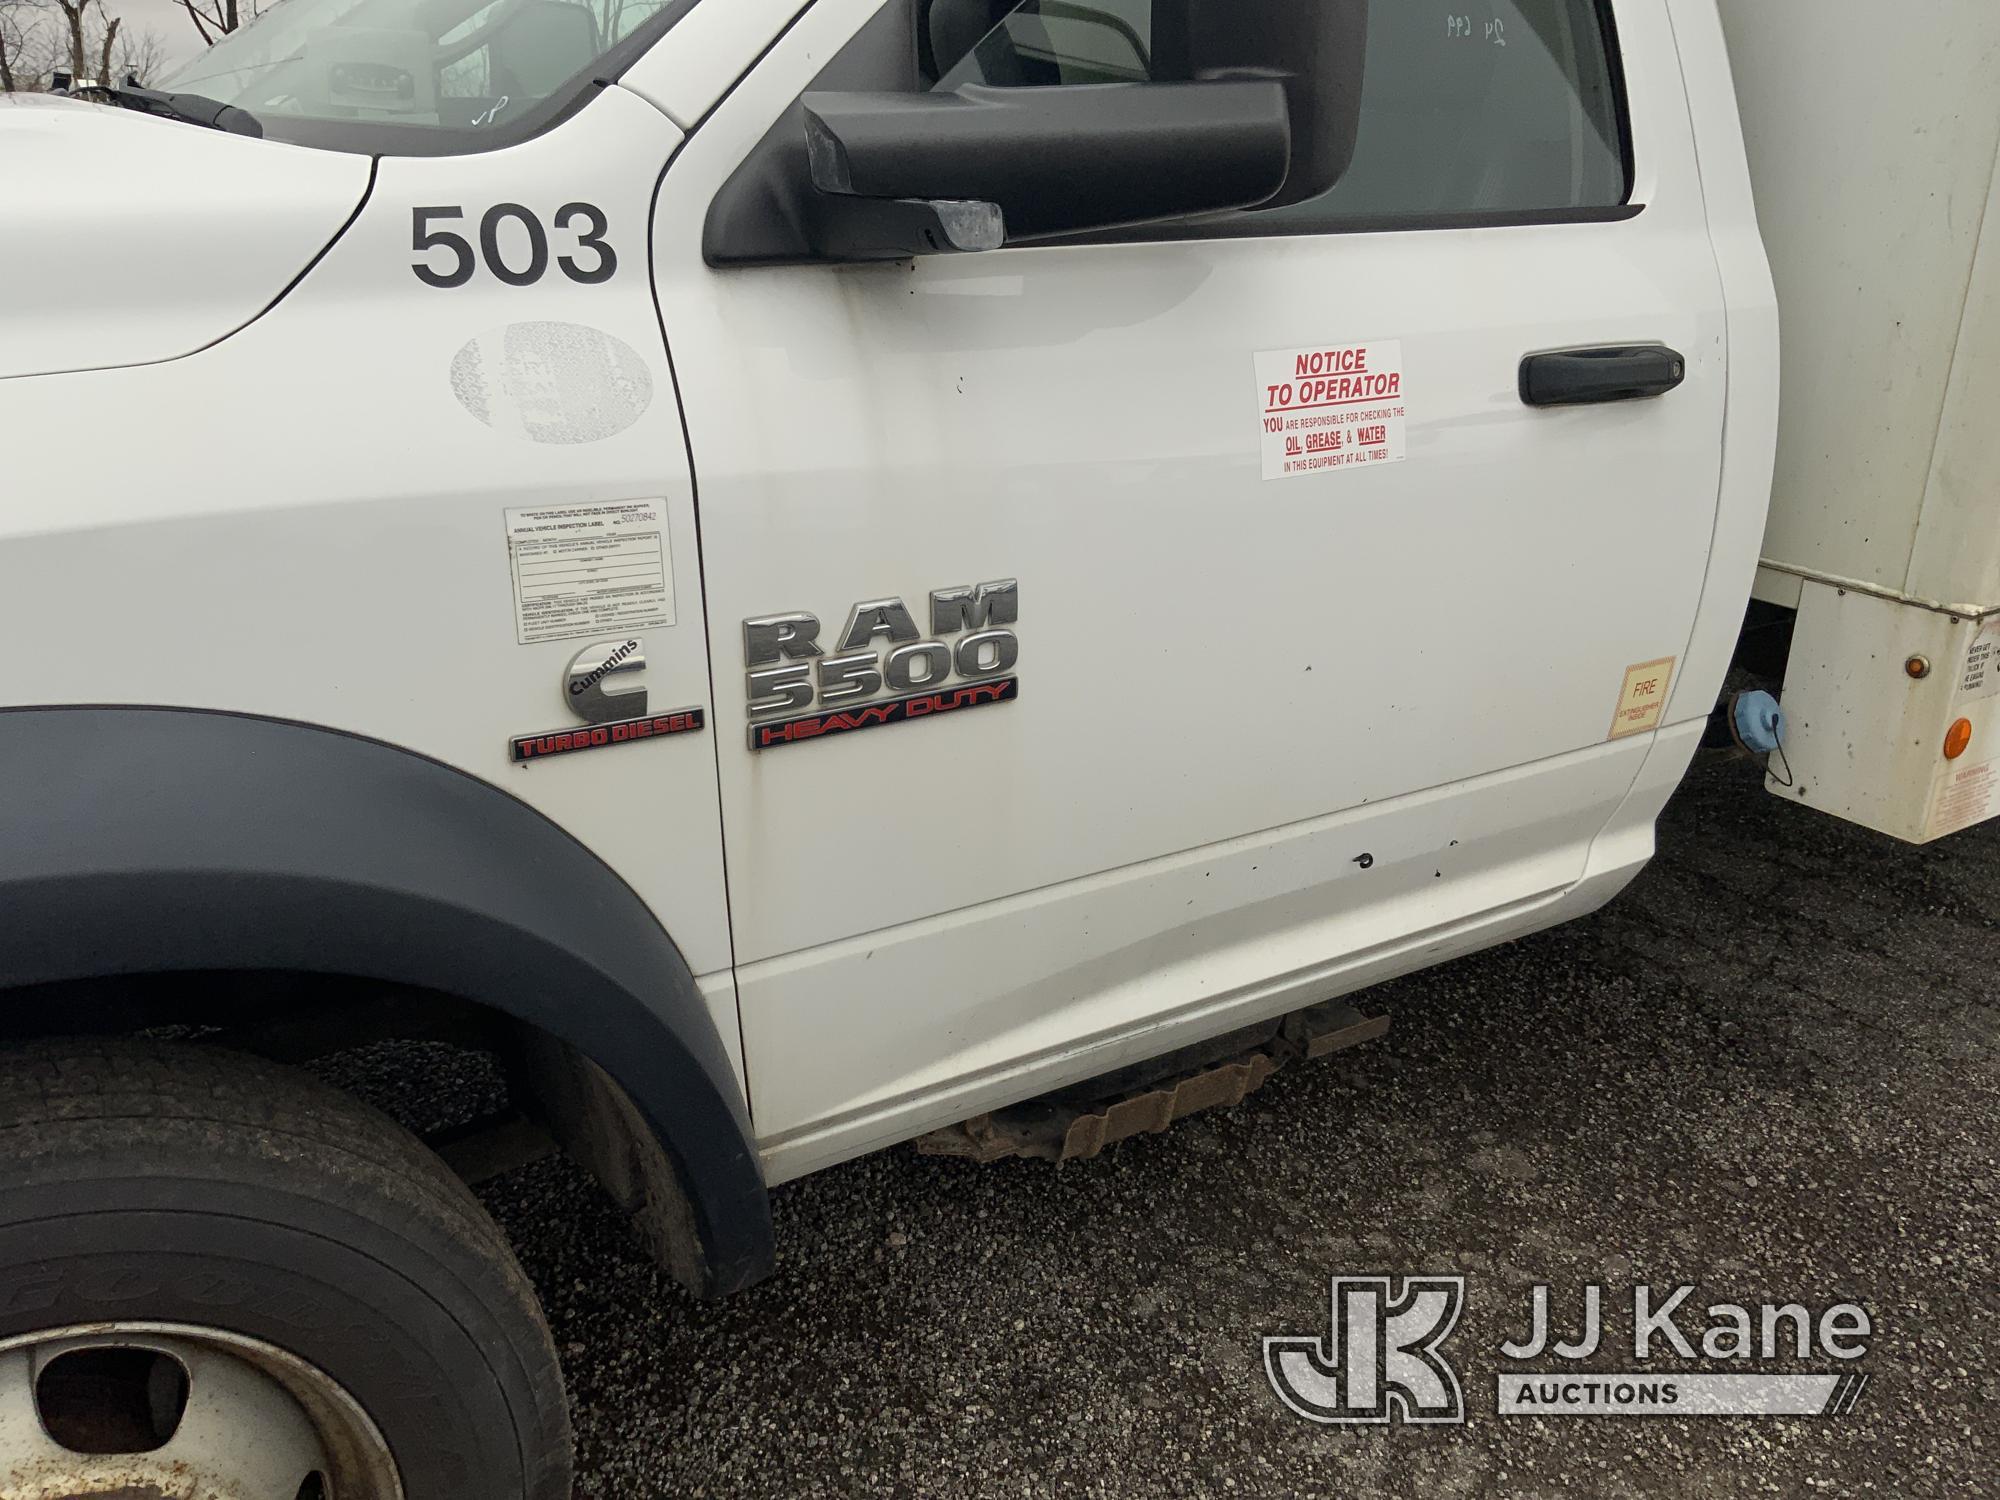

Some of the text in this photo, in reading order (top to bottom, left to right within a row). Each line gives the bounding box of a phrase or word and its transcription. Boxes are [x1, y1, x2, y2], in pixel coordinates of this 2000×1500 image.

[411, 202, 618, 289] 503
[1295, 348, 1366, 375] NOTICE
[1267, 373, 1400, 406] TO OPERATOR
[1263, 407, 1404, 433] YOU ARE RESPONSIBLE FOR CHECKING THE
[1346, 430, 1353, 443] &
[1357, 425, 1386, 442] WATER
[1284, 462, 1291, 472] IN
[1292, 459, 1307, 472] THIS
[1308, 455, 1345, 469] EQUIPMENT
[1346, 453, 1353, 464] AT
[1355, 451, 1367, 462] ALL
[1368, 449, 1389, 461] TIMES!
[743, 577, 1018, 667] RAM
[569, 638, 638, 697] Cummins
[746, 628, 1019, 719] 5500
[1632, 678, 1658, 698] FIRE
[761, 682, 1013, 746] HEAVY DUTY
[518, 713, 700, 758] TURBO DIESEL
